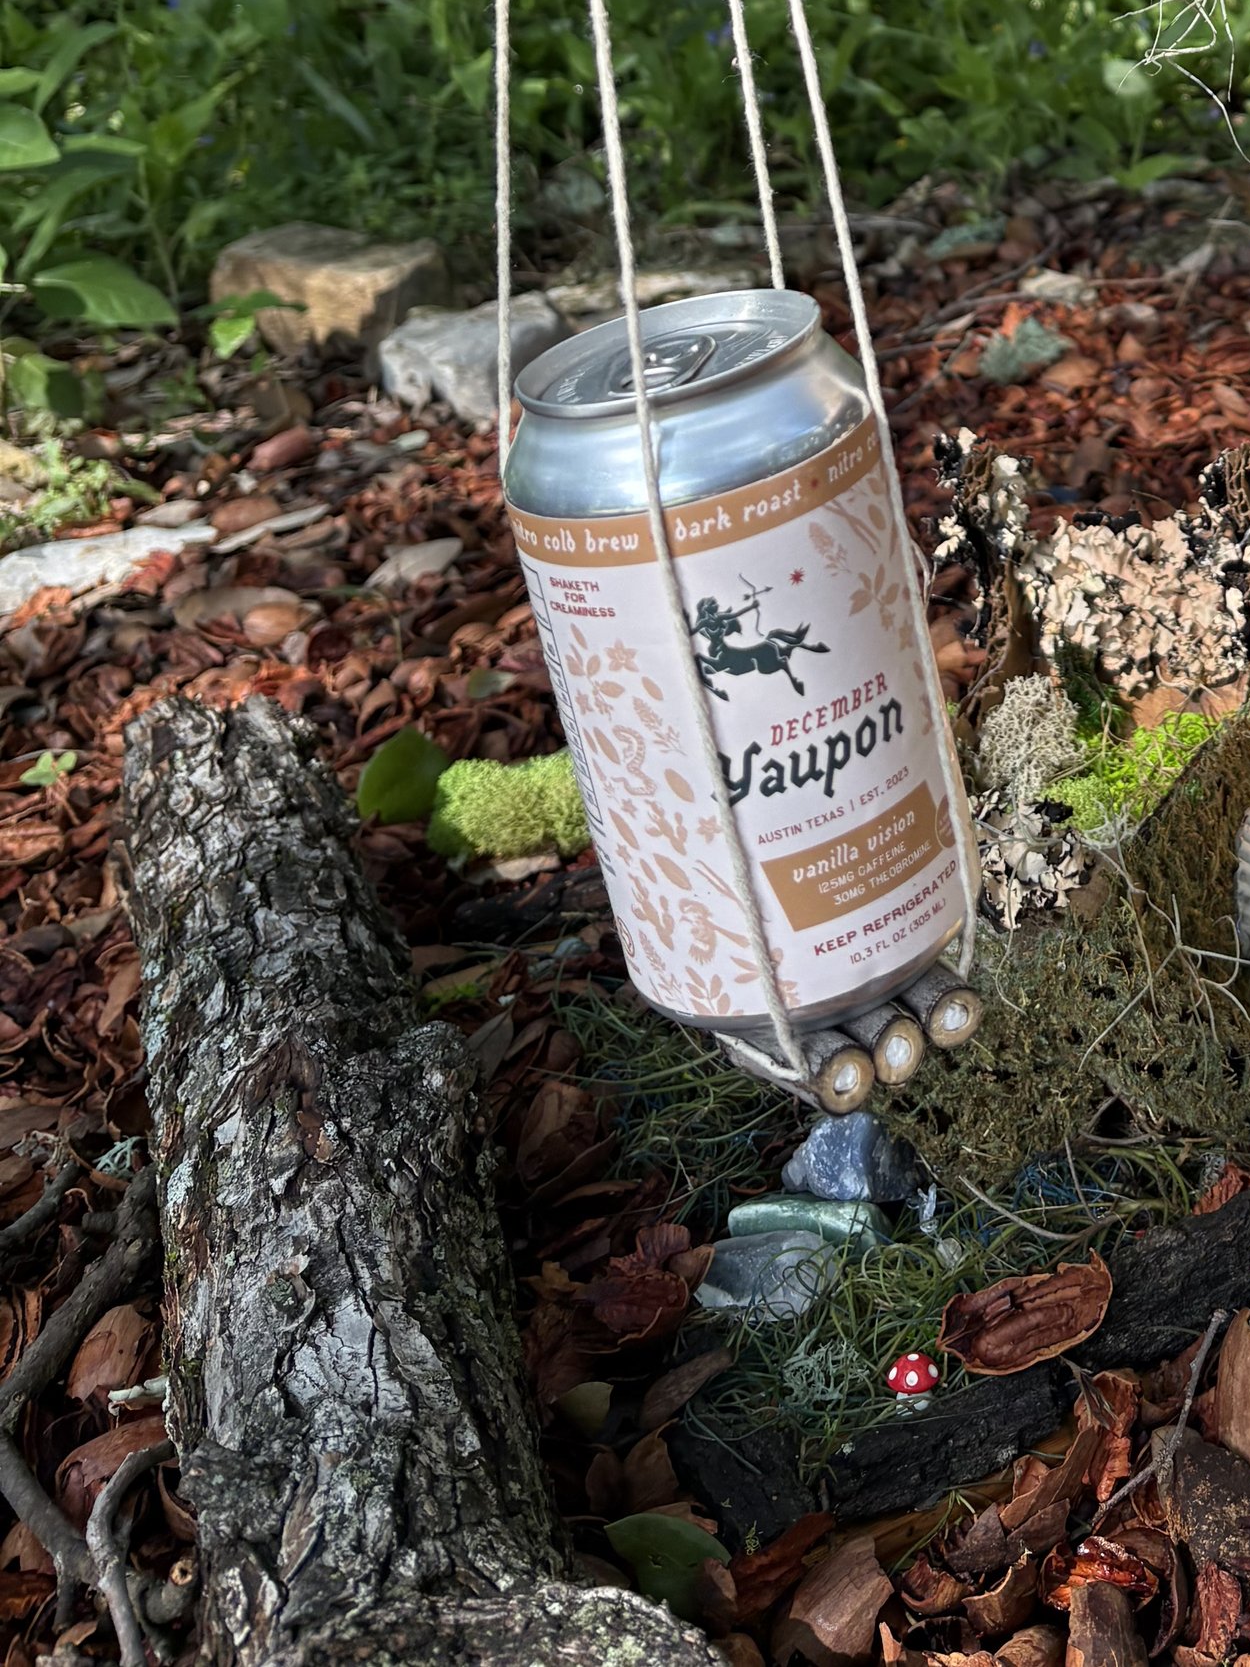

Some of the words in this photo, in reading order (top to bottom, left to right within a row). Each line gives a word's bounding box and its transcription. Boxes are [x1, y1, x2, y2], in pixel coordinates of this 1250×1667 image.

[544, 528, 576, 553] cold
[584, 528, 639, 553] brew
[675, 506, 732, 542] dark
[742, 479, 803, 524] roast
[828, 446, 863, 483] nitro
[549, 577, 600, 592] SHAKETH
[549, 600, 616, 617] CREAMINESS
[564, 592, 587, 604] FOR
[771, 671, 888, 747] DECEMBER
[711, 697, 904, 808] Yaupon
[757, 823, 803, 846] AUSTIN
[806, 806, 845, 828] TEXAS
[859, 788, 885, 811] EST.
[886, 765, 910, 790] 2023
[793, 843, 859, 883] vanilla
[868, 809, 915, 850] vision
[818, 871, 855, 894] 125MG
[858, 841, 907, 877] CAFFEINE
[833, 883, 866, 906] 30MG
[869, 839, 932, 888] THEOBROMINE
[814, 930, 857, 956] KEEP
[862, 859, 957, 936] REFRIGERATED
[850, 947, 873, 965] 10.3
[875, 939, 891, 953] FL
[892, 928, 908, 943] OZ
[909, 910, 932, 933] (305
